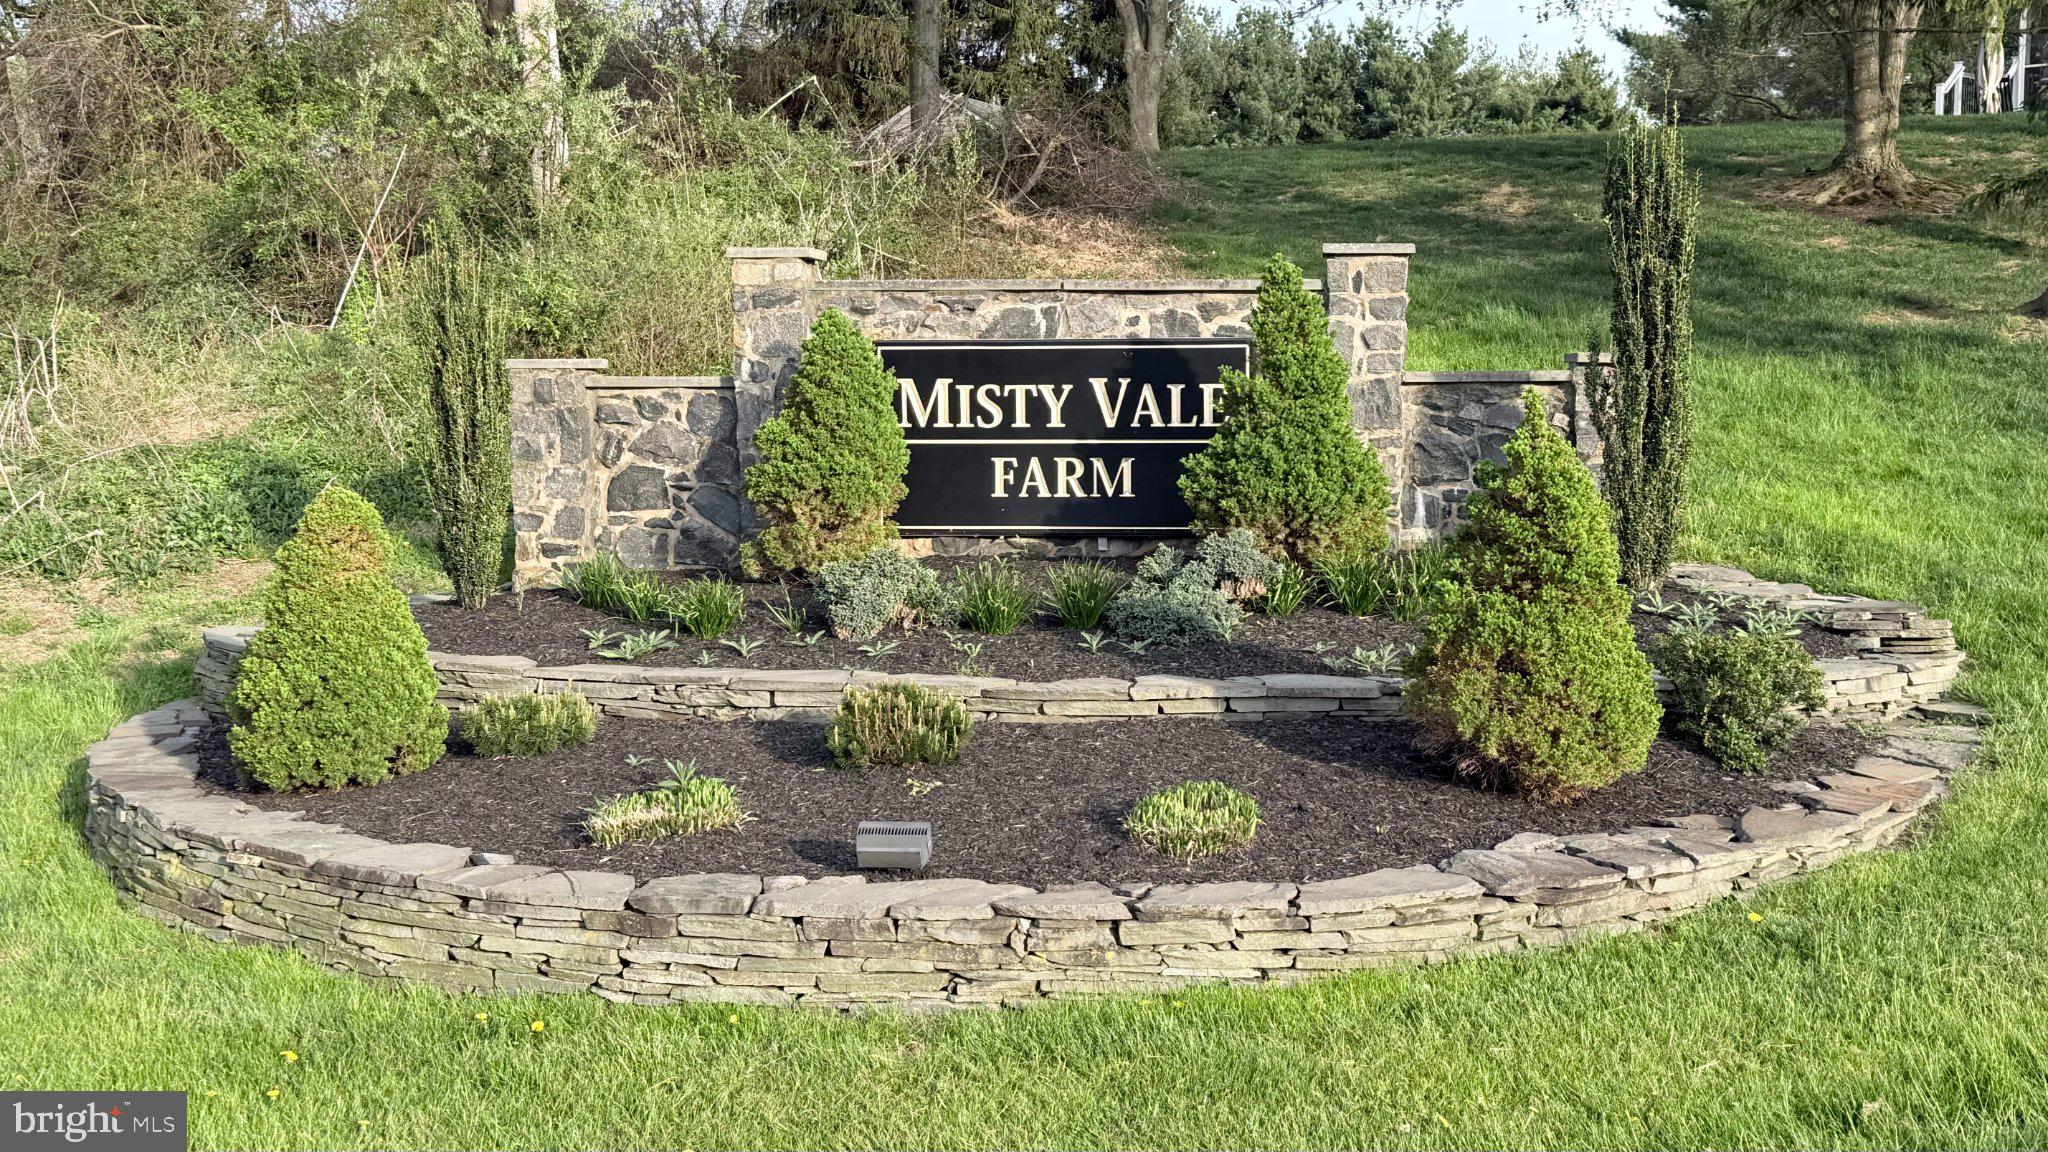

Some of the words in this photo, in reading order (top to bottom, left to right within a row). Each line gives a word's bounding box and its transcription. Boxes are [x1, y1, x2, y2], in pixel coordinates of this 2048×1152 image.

[897, 377, 1073, 428] MISTY
[1088, 377, 1230, 428] VALE
[990, 456, 1136, 498] FARM
